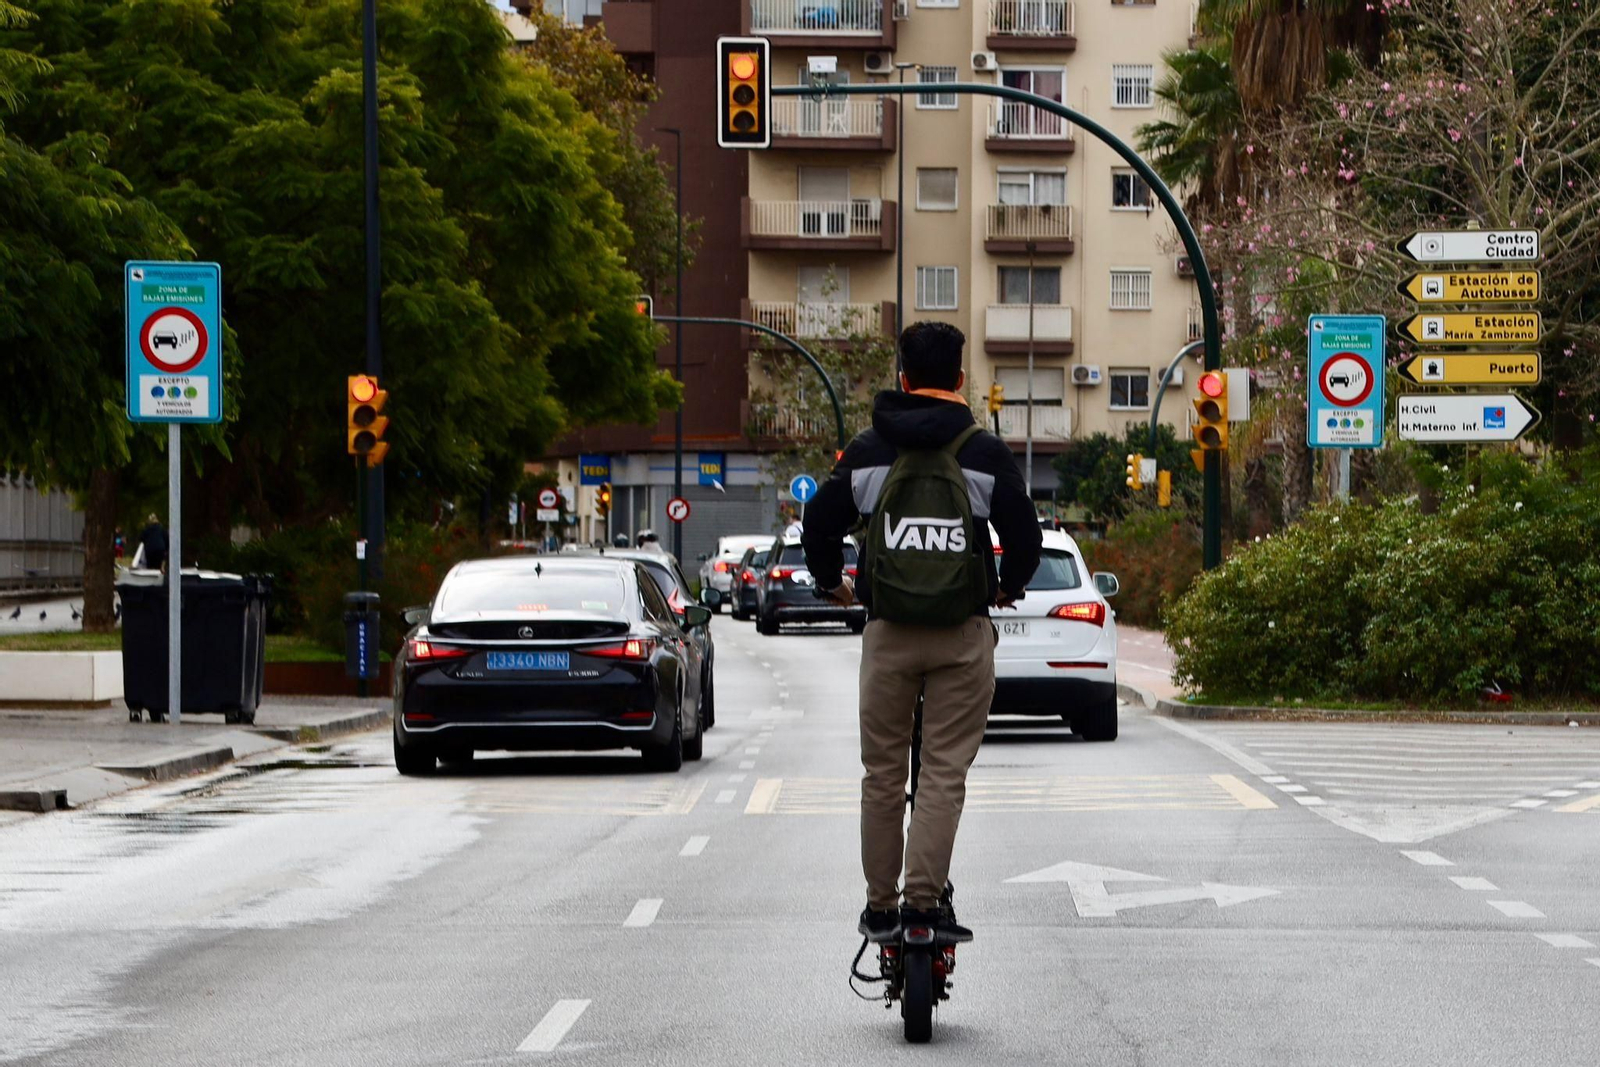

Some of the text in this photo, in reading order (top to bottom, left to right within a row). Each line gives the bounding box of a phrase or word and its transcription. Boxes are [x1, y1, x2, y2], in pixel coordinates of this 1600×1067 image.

[1487, 233, 1534, 245] Centro
[1485, 246, 1534, 258] Ciudad
[1449, 274, 1534, 286] Estación de
[1460, 287, 1534, 299] Autobuses
[1475, 315, 1534, 328] Estación
[1445, 329, 1534, 340] María Zambrano
[1489, 363, 1534, 374] Puerto
[884, 512, 967, 553] VANS
[1003, 622, 1027, 635] GZT
[499, 653, 534, 667] 3340
[538, 653, 566, 667] NBN
